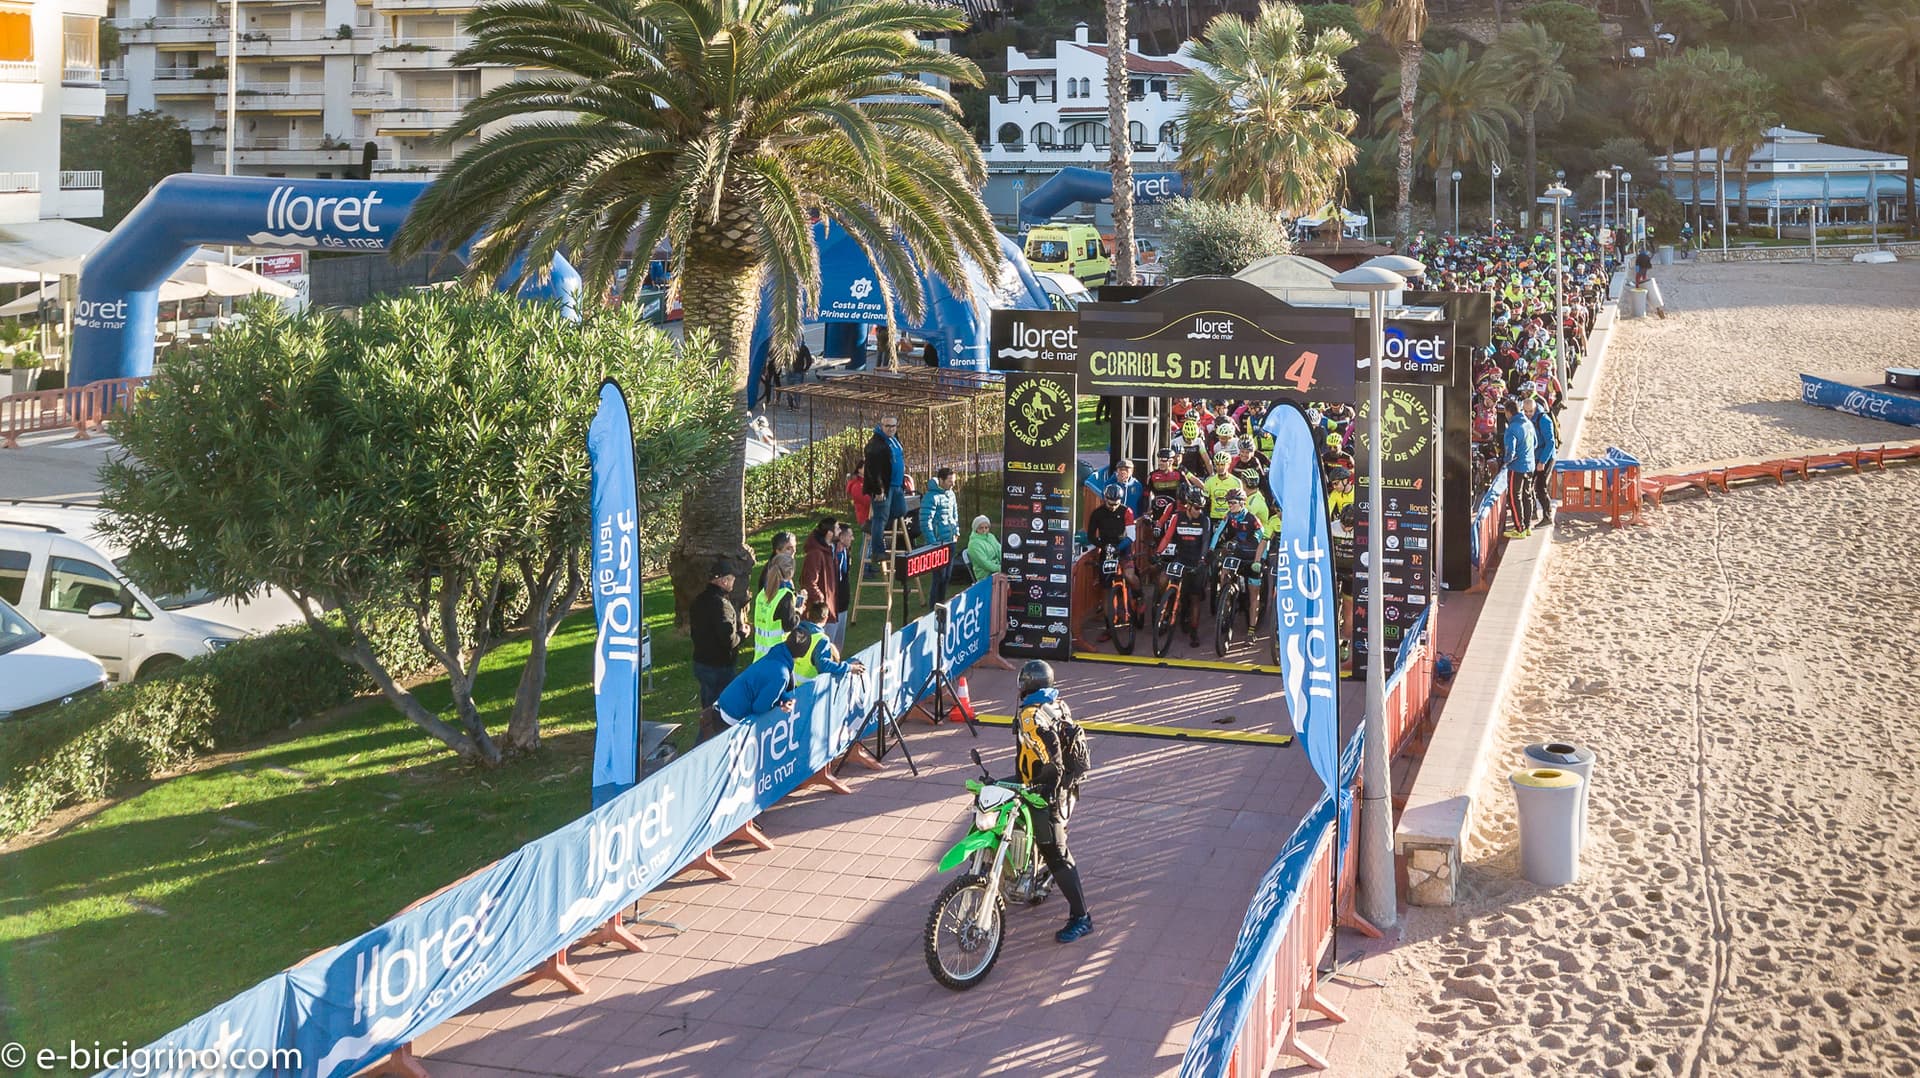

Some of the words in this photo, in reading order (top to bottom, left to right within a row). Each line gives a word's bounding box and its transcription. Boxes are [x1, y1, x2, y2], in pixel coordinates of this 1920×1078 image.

[267, 186, 383, 232] lloret
[322, 235, 346, 248] de
[350, 237, 384, 249] mar
[76, 293, 128, 319] loret
[820, 310, 850, 319] Pirineu
[851, 311, 861, 319] de
[862, 312, 888, 320] Girona
[832, 301, 856, 309] Costa
[857, 302, 881, 310] Brava
[88, 320, 101, 328] de
[102, 321, 126, 329] mar
[1012, 321, 1079, 349] lloret
[1195, 317, 1235, 334] lloret
[1041, 350, 1055, 361] de
[1056, 352, 1078, 361] mar
[1382, 330, 1446, 360] loret
[950, 358, 976, 367] Girona
[1089, 351, 1183, 379] CORRIOLS
[1190, 360, 1211, 380] DE
[1219, 354, 1275, 381] L'AVI
[1284, 350, 1319, 393] 4
[1404, 360, 1418, 371] de
[1421, 362, 1445, 372] mar
[1890, 374, 1897, 384] 2
[1007, 378, 1038, 407] PENYA
[1038, 377, 1073, 412] CICLISTA
[1392, 389, 1430, 425] CICLISTA
[1843, 390, 1893, 415] lloret
[1008, 420, 1037, 448] LLORET
[1040, 438, 1053, 447] DE
[1054, 422, 1072, 442] MAR
[1394, 452, 1408, 462] DE
[1408, 436, 1428, 457] MAR
[1056, 462, 1067, 474] 4
[1412, 478, 1423, 490] 4
[758, 778, 773, 796] de
[586, 784, 675, 890] lloret
[626, 862, 650, 890] de
[353, 890, 501, 1026] lloret
